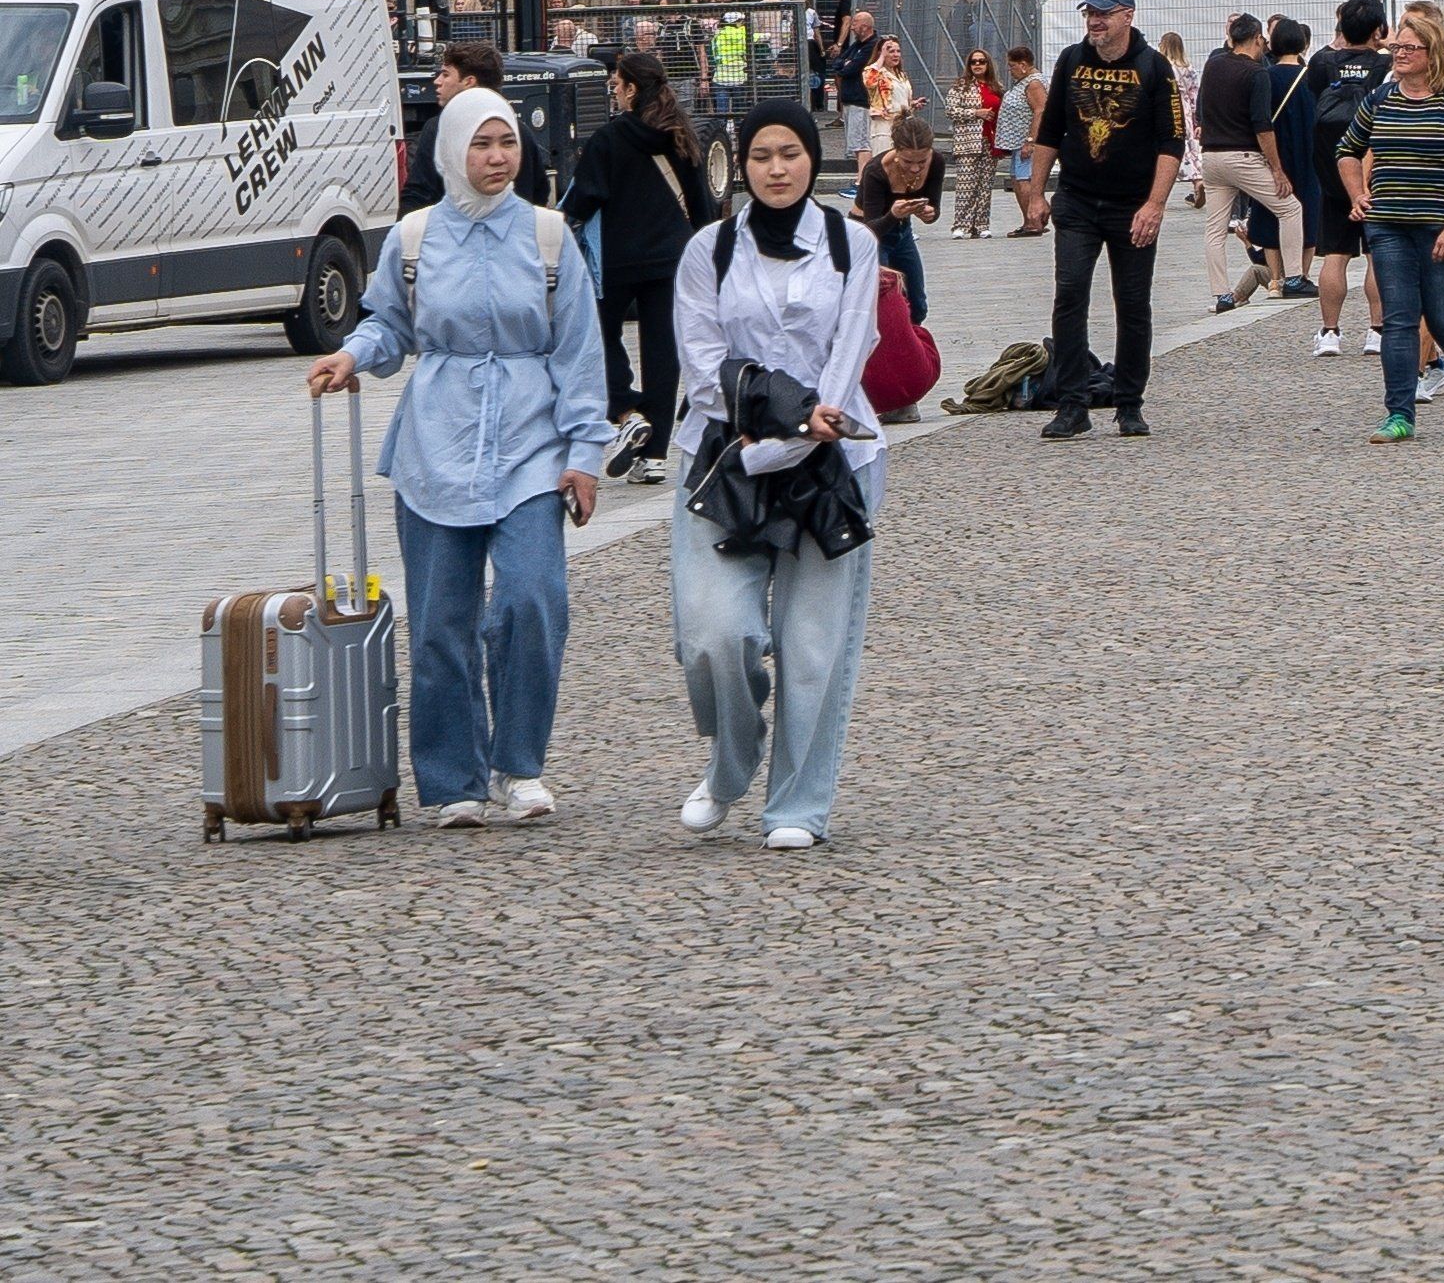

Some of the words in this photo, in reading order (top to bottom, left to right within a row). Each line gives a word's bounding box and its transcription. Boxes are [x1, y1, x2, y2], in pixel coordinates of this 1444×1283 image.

[1081, 81, 1124, 93] 2024
[1339, 69, 1370, 79] JAPAN
[224, 31, 326, 182] LEHMANN
[312, 81, 336, 115] GmbH
[235, 121, 298, 215] CREW
